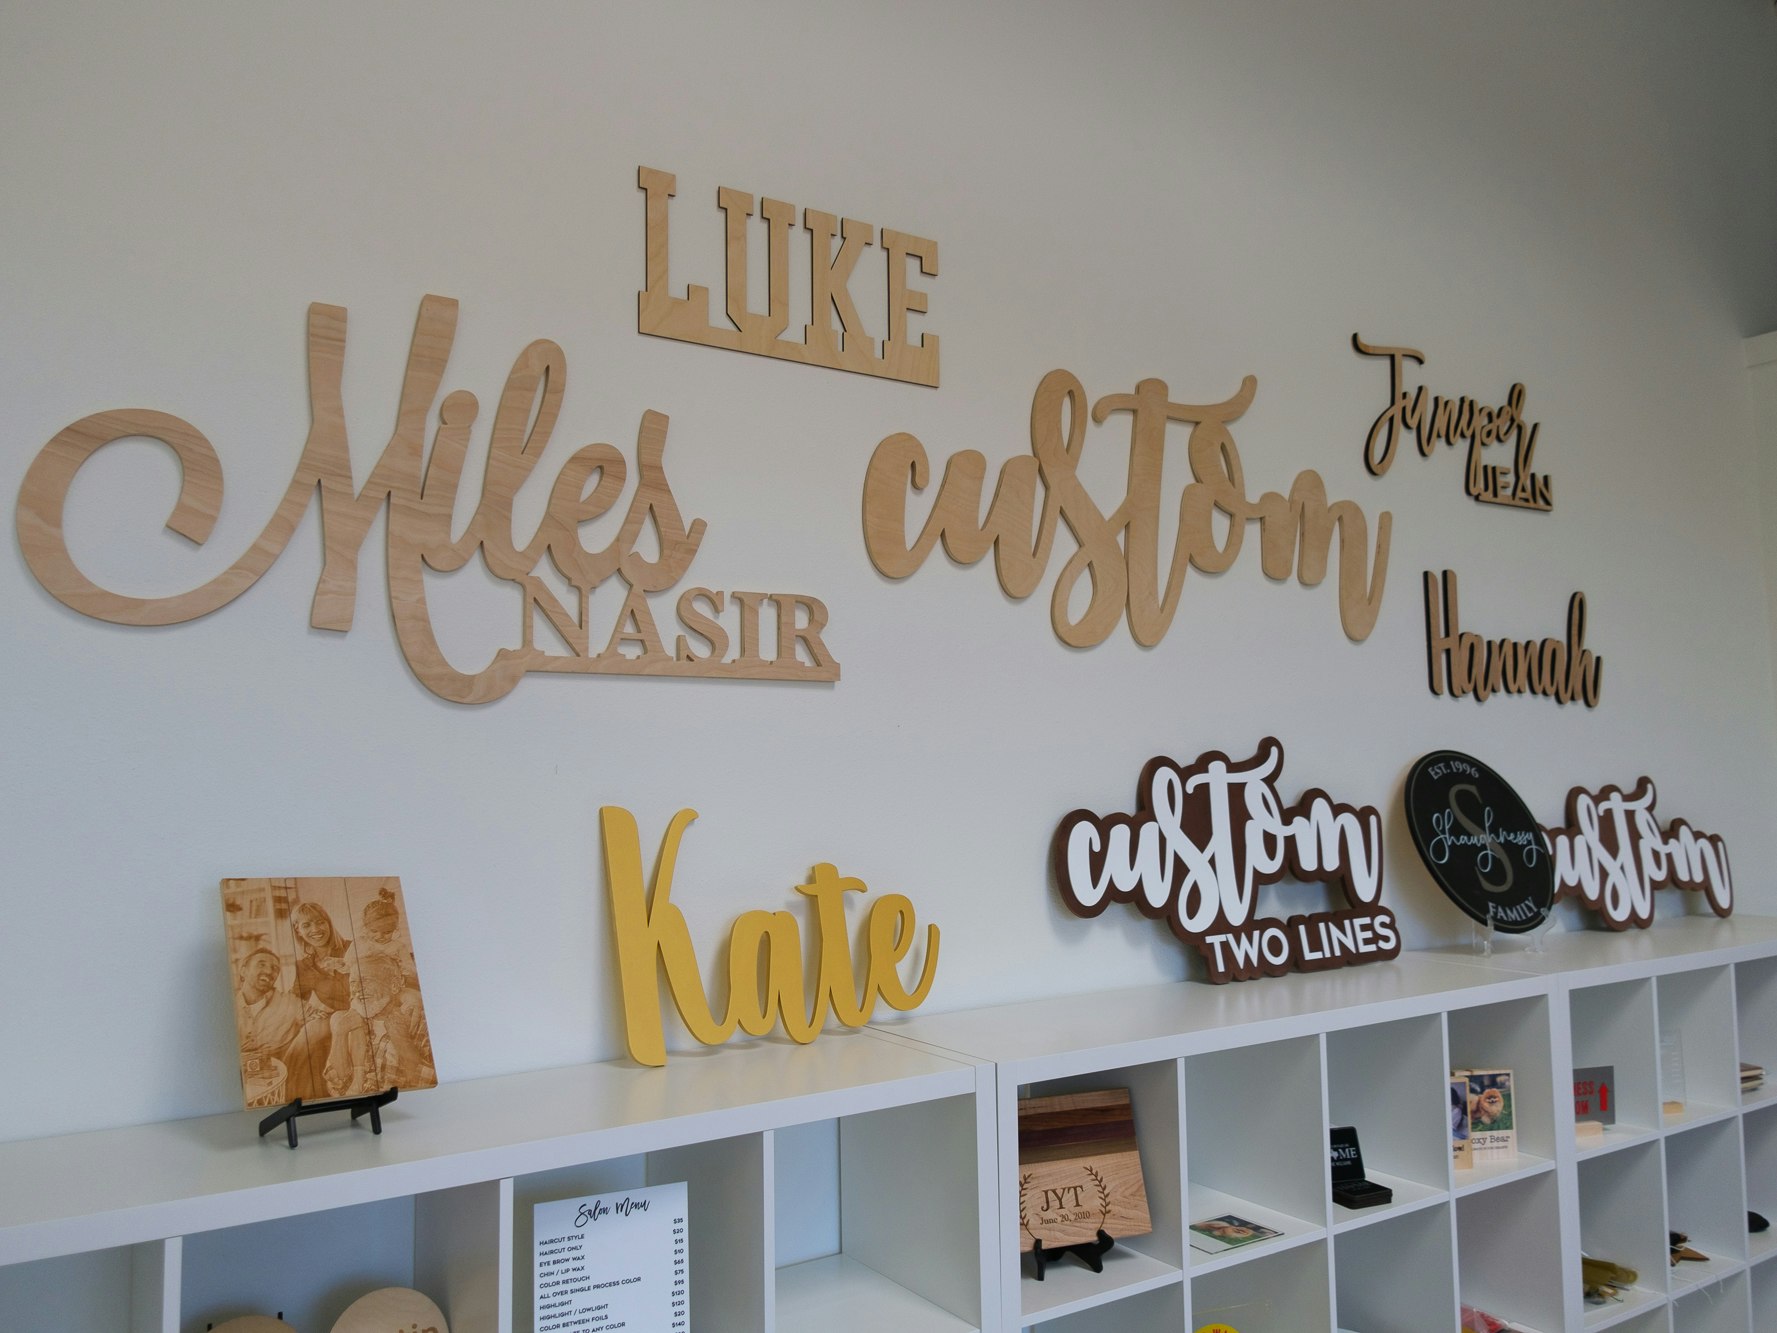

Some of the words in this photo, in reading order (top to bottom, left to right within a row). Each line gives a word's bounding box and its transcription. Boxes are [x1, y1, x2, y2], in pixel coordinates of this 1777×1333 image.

[638, 165, 939, 388] LUKE
[1351, 332, 1541, 497] Juniper
[15, 293, 707, 705] Miles
[1479, 464, 1553, 511] JEAN
[862, 369, 1393, 649] custom
[520, 576, 841, 676] NASIR
[1423, 569, 1602, 708] Hannah
[1427, 762, 1450, 780] EST.
[1450, 760, 1480, 779] 1996
[1067, 745, 1380, 934] custom
[1429, 806, 1545, 873] Shaughnessy
[1488, 896, 1538, 922] FAMILY
[599, 805, 940, 1067] Kate
[1205, 927, 1290, 973] TWO
[1298, 915, 1397, 962] LINES
[1472, 1136, 1488, 1146] oxy
[574, 1200, 611, 1228] Salon
[615, 1197, 651, 1216] Menu
[1041, 1185, 1085, 1212] JYT
[1040, 1216, 1058, 1225] June
[1074, 1210, 1091, 1220] 2010
[539, 1236, 566, 1246] HAIRCUT
[567, 1233, 585, 1242] STYLE
[539, 1247, 566, 1256] HAIRCUT
[567, 1244, 583, 1252] ONLY
[672, 1227, 684, 1235] $20
[539, 1260, 551, 1268] EYE
[552, 1257, 571, 1266] BROW
[571, 1254, 586, 1262] WAX
[560, 1267, 571, 1275] LIP
[539, 1280, 561, 1289] COLOR
[561, 1275, 591, 1285] RETOUCH
[551, 1290, 569, 1298] OVER
[569, 1285, 592, 1295] SINGLE
[592, 1280, 620, 1290] PROCESS
[621, 1277, 642, 1285] COLOR
[539, 1299, 573, 1311] HIGHLIGHT
[539, 1310, 573, 1321] HIGHLIGHT
[578, 1303, 609, 1314] LOWLIGHT
[671, 1289, 685, 1297] $120
[539, 1323, 561, 1332] COLOR
[562, 1317, 590, 1328] BETWEEN
[591, 1314, 609, 1323] FOILS
[671, 1299, 685, 1308] $120
[591, 1325, 605, 1333] ANY
[605, 1321, 626, 1330] COLOR
[673, 1310, 685, 1318] $20
